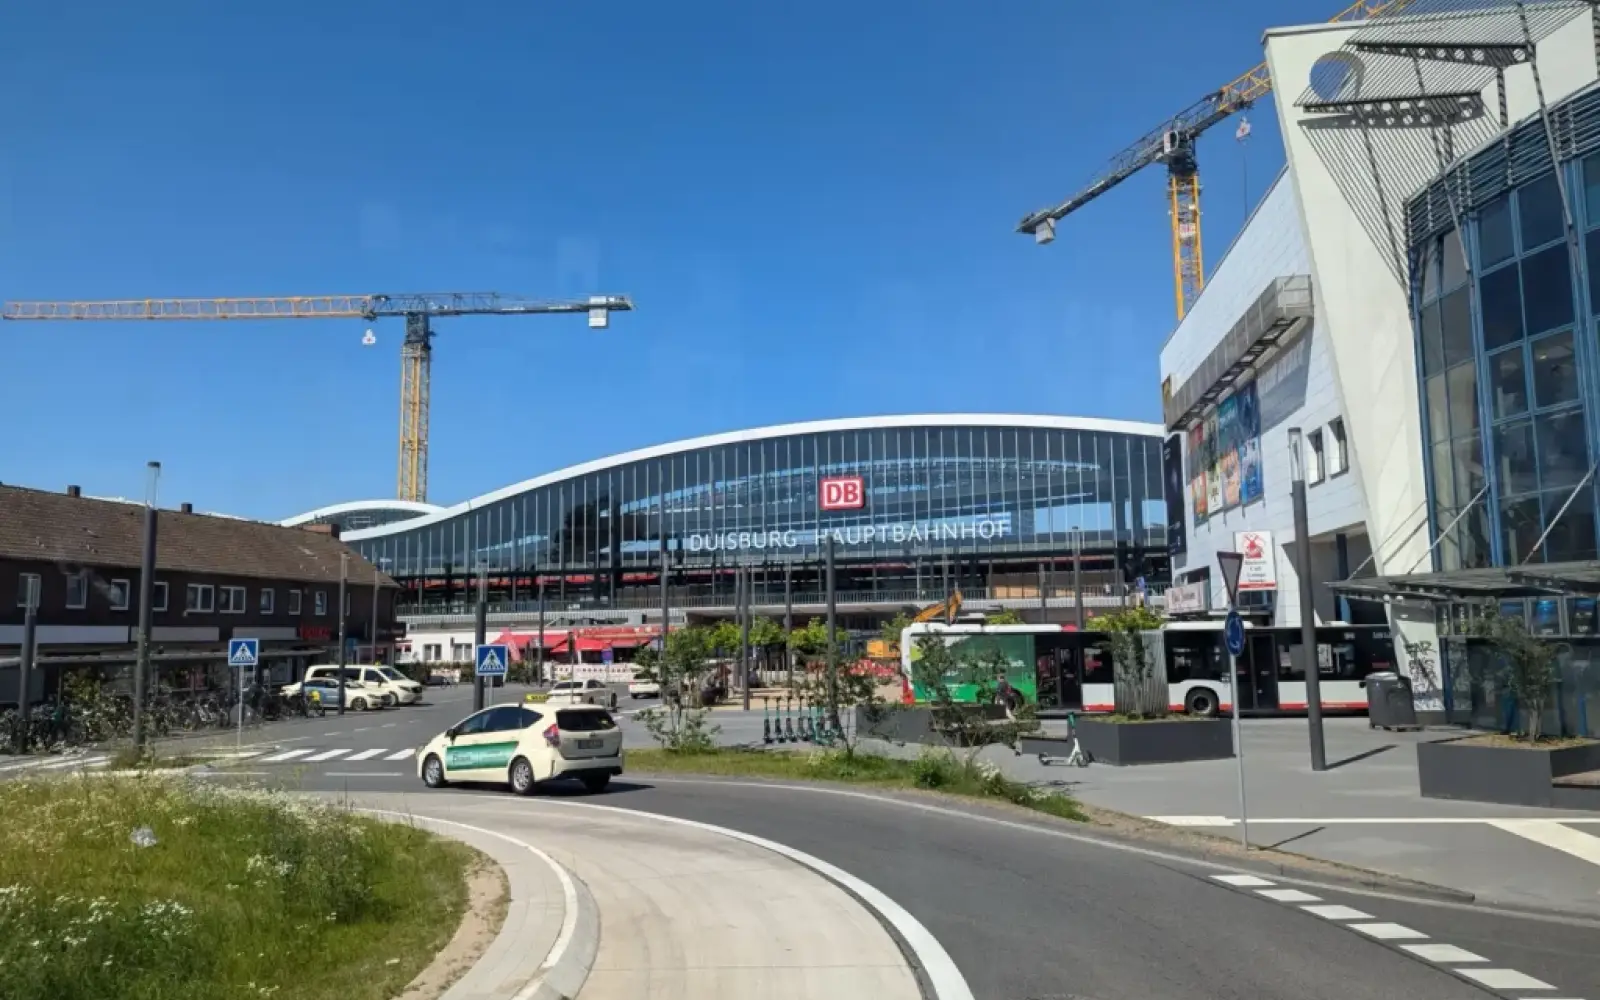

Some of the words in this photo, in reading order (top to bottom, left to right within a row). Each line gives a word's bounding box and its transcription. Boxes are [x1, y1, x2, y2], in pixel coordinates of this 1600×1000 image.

[826, 483, 859, 504] DB
[689, 530, 797, 552] DUISBURG
[815, 520, 1008, 545] HAUPTBAHNHOF
